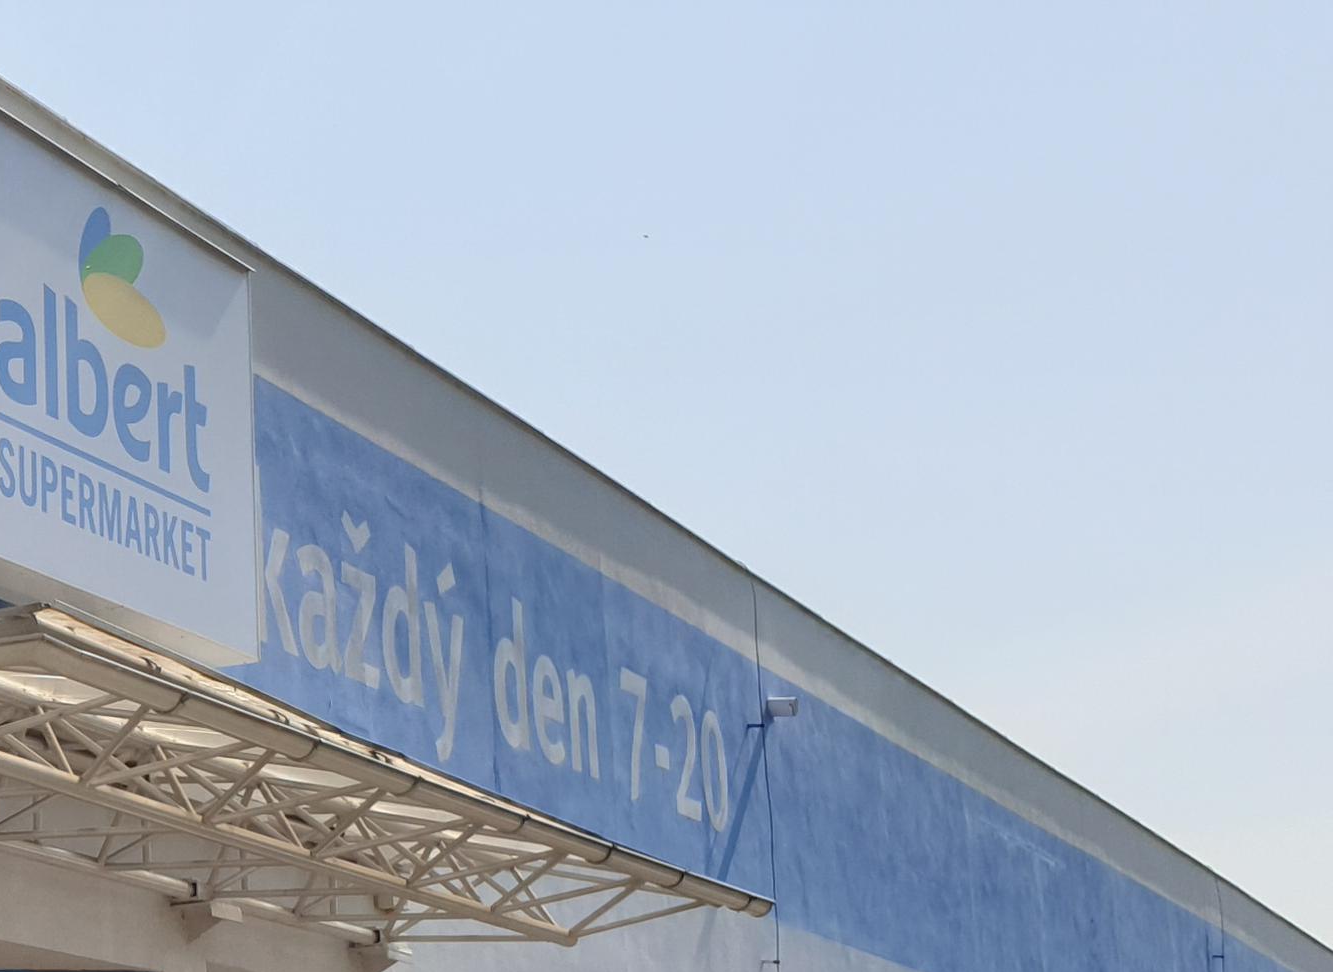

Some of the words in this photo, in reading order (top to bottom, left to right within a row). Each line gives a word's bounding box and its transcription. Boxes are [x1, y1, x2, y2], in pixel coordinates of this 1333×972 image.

[261, 509, 464, 762] každý
[494, 596, 600, 781] den
[620, 666, 728, 832] 7-20
